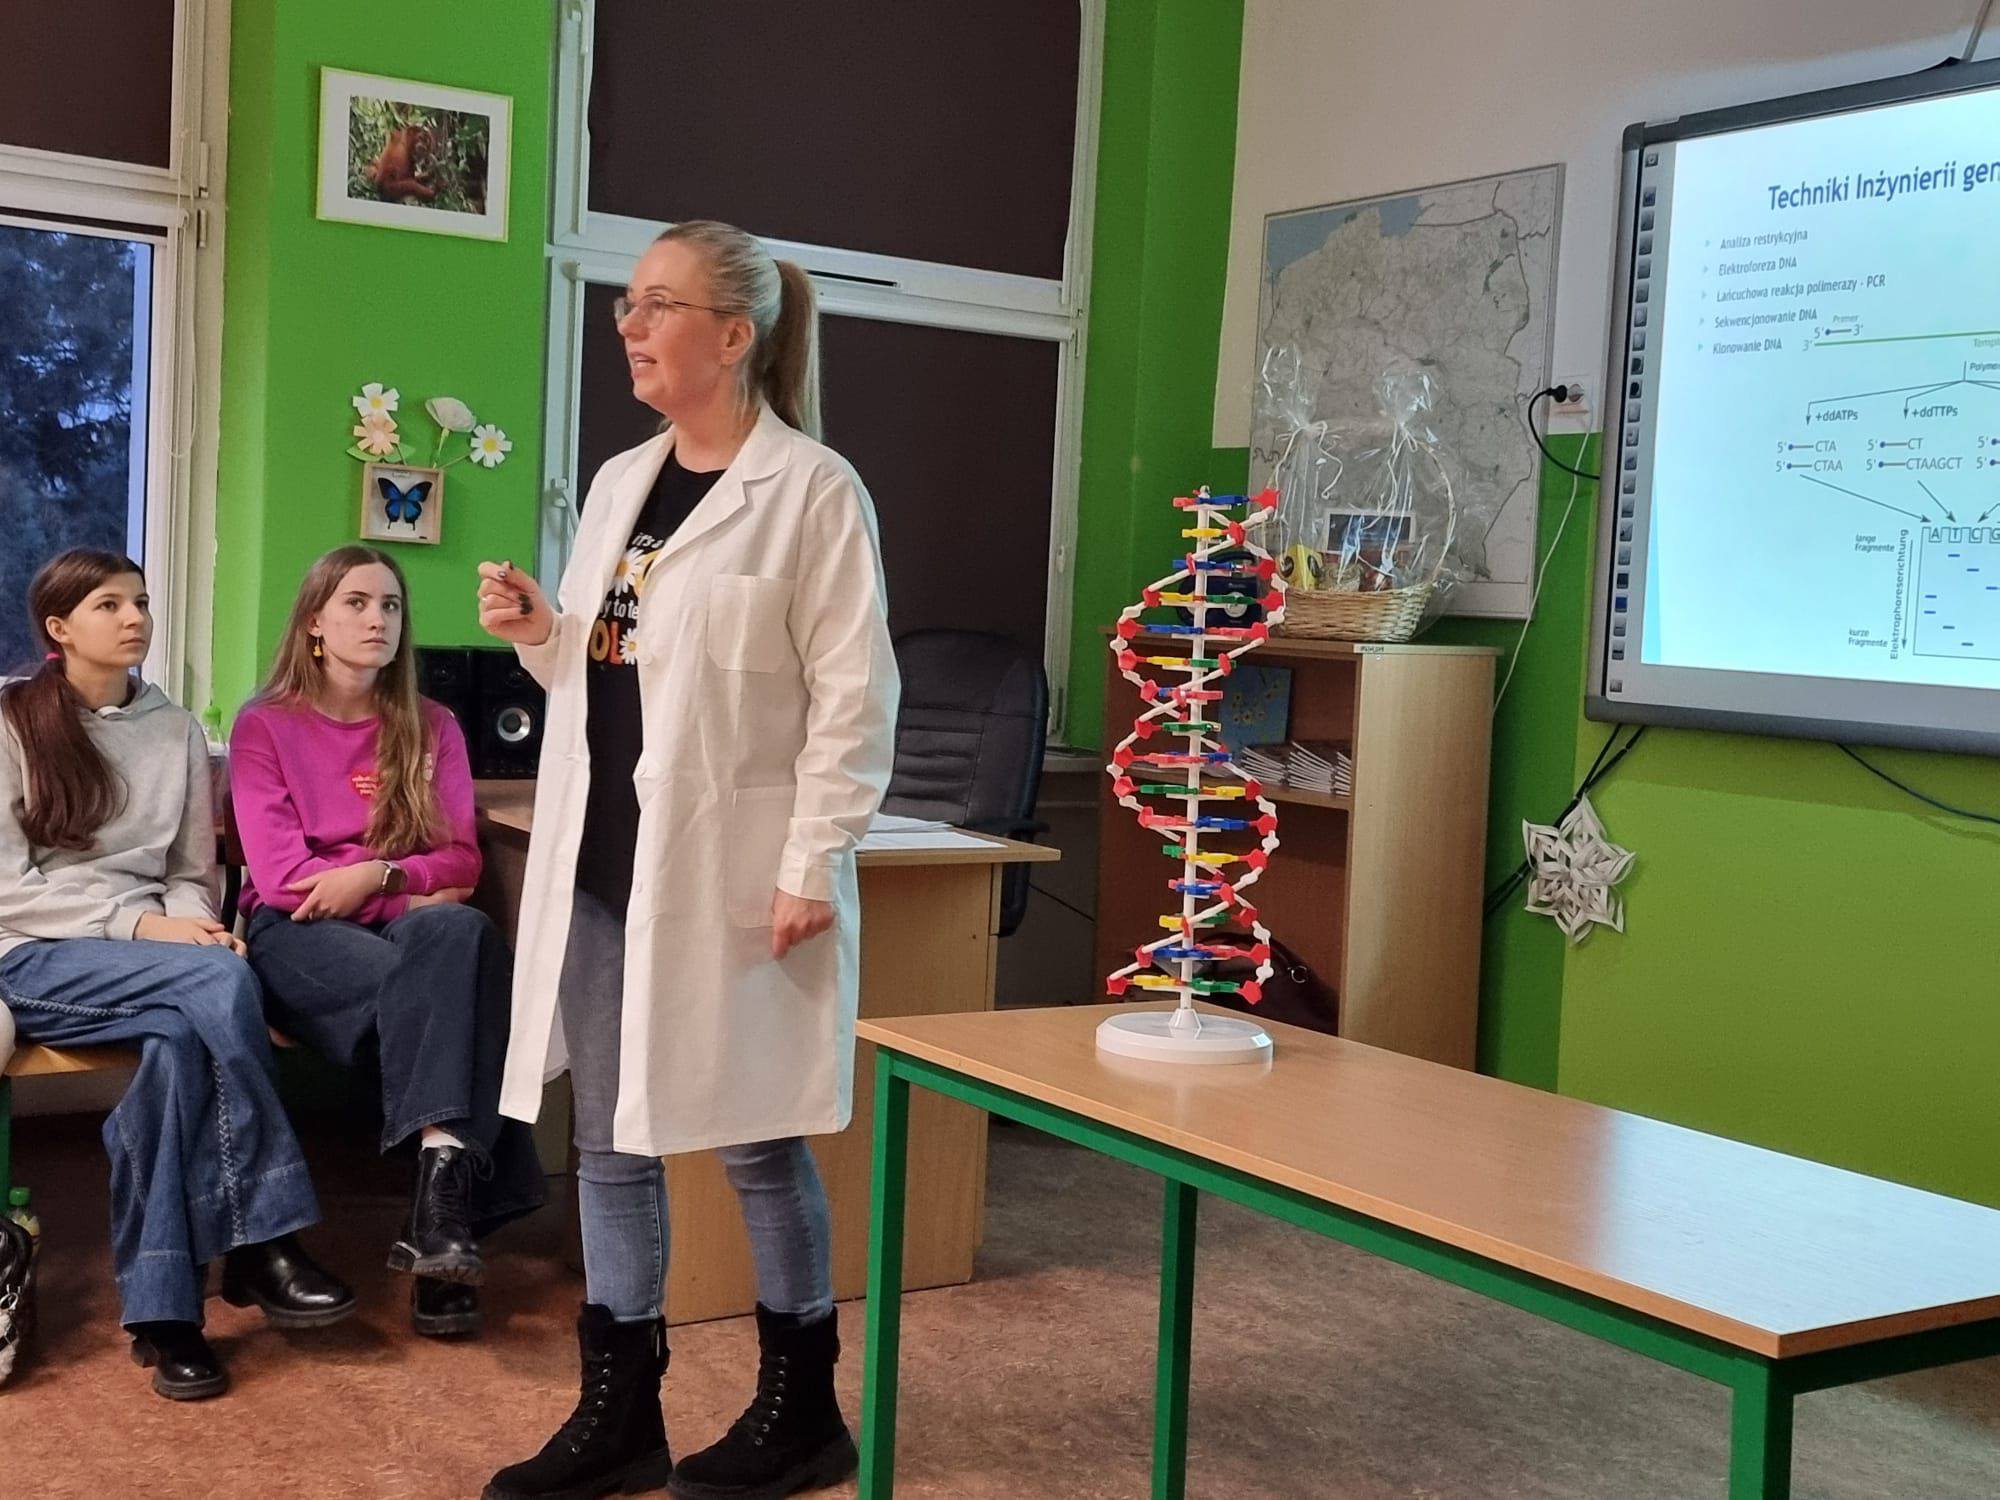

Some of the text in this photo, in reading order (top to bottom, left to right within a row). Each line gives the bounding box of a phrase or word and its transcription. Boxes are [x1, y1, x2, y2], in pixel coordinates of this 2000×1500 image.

[1768, 175, 1849, 210] Techniki
[1856, 160, 1956, 202] Inżynierii
[1720, 230, 1808, 249] Analiza restrykcyjna
[1718, 256, 1797, 276] Elektroforeza DNA
[1771, 282, 1804, 298] reakcja
[1806, 279, 1857, 296] polimerazy
[1867, 274, 1886, 288] PCR
[1714, 308, 1817, 329] Sekwencjonowanie DNA
[1713, 338, 1782, 355] Klonowanie DNA
[1815, 409, 1858, 421] +ddATPs
[1912, 405, 1959, 418] +ddTTPs
[1815, 439, 1837, 452] CTA
[1907, 437, 1924, 450] CT
[1813, 459, 1843, 472] CTAA
[1905, 457, 1963, 470] CTAAGCT
[1931, 527, 1940, 540] A
[1951, 527, 1960, 540] T
[1971, 527, 1981, 540] C
[613, 598, 627, 618] to
